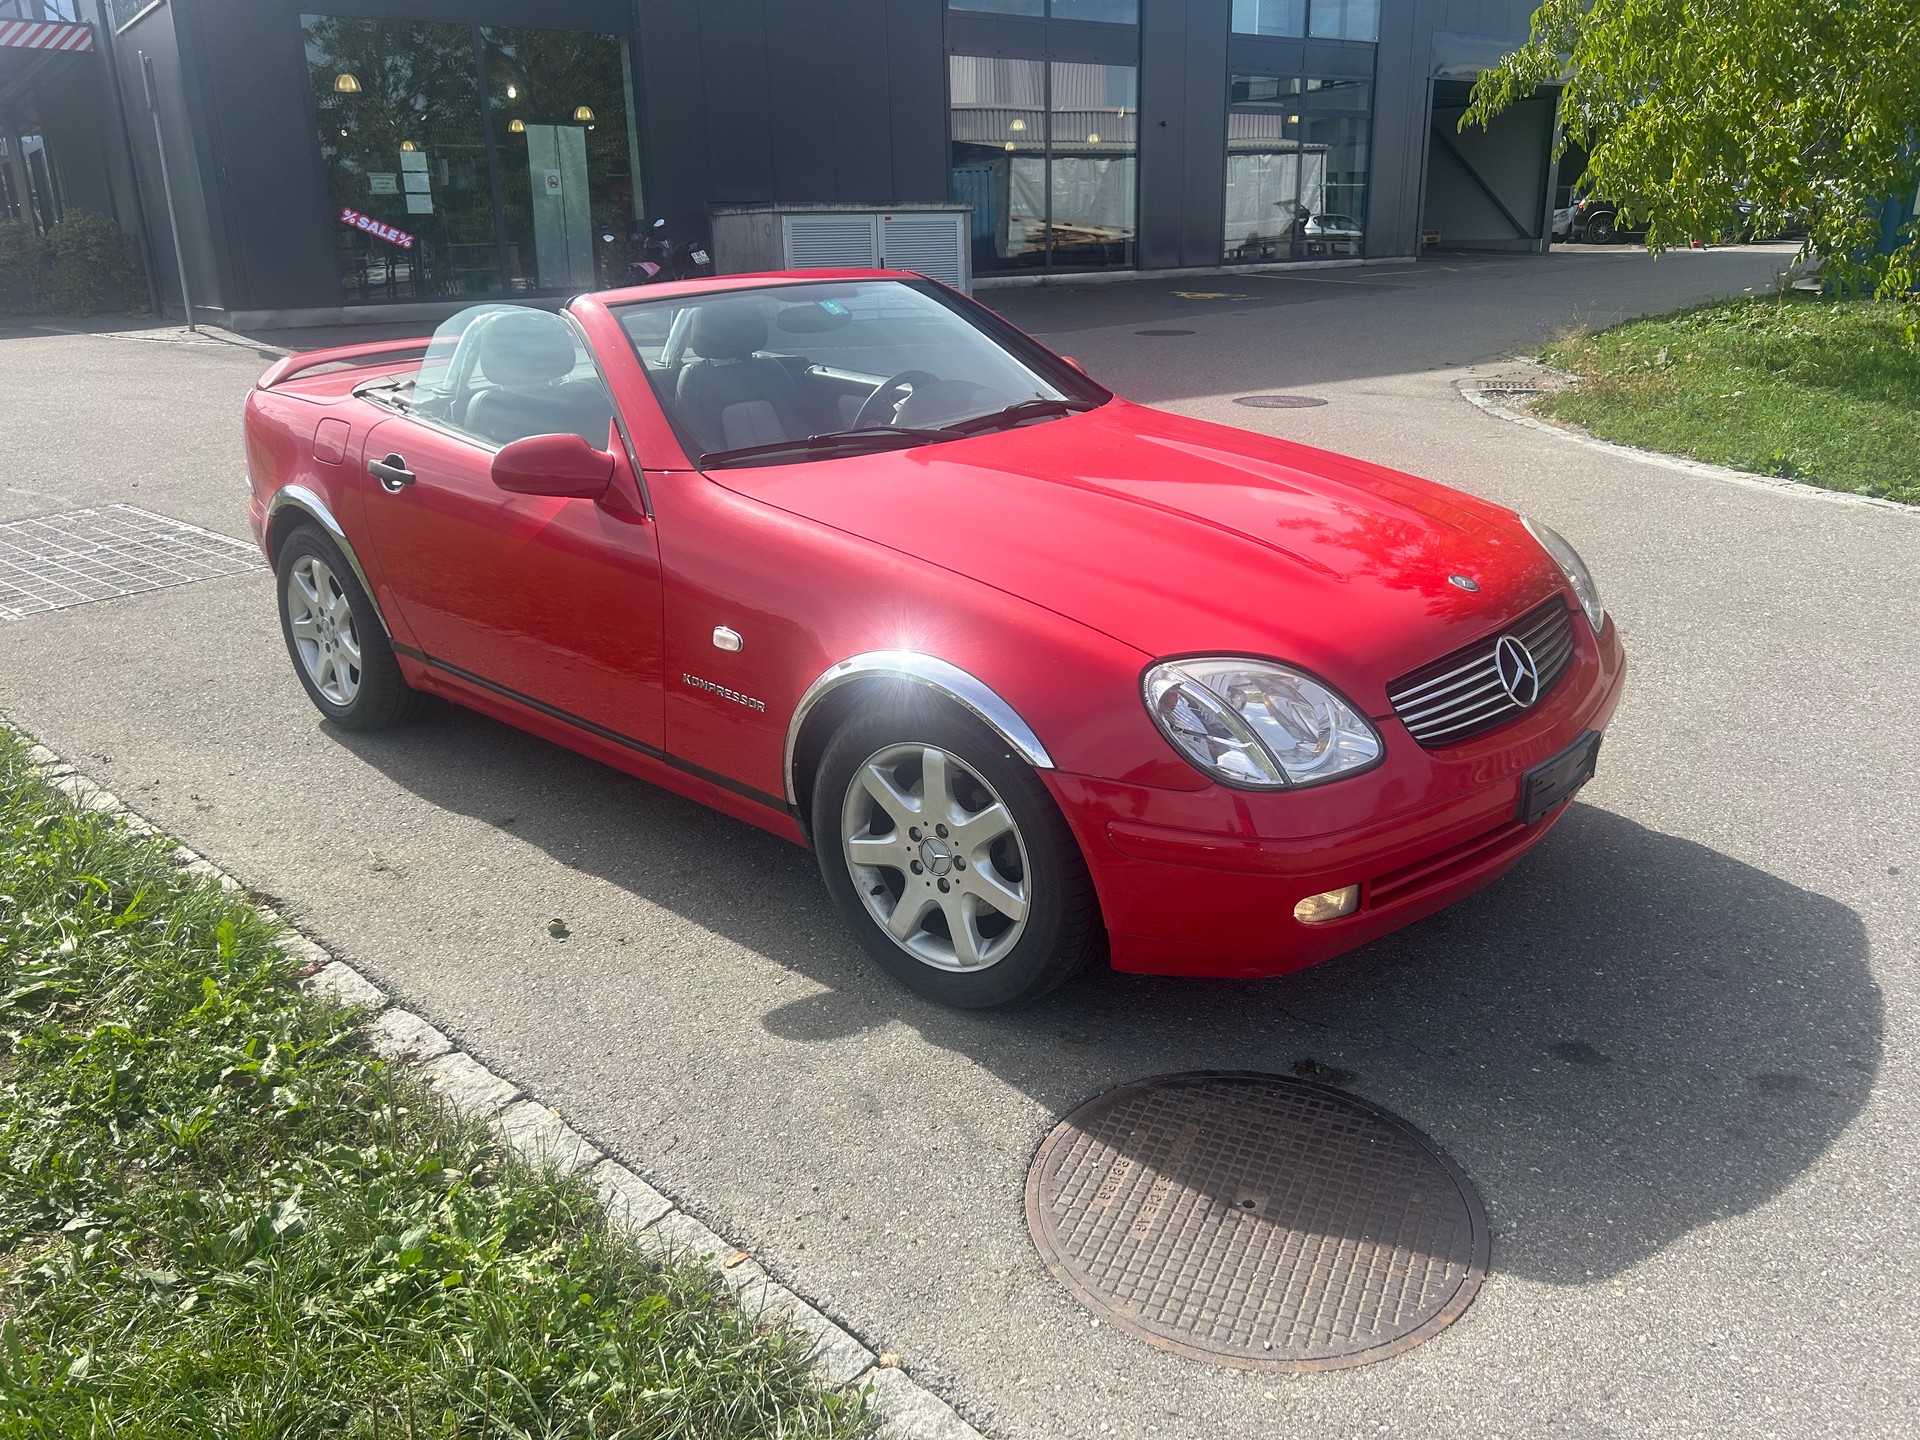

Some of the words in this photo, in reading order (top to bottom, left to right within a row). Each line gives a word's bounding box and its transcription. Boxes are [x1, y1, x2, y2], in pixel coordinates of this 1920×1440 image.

[683, 673, 765, 712] KOMPRESSOR
[1098, 1138, 1141, 1200] OBERBURG
[1134, 1218, 1151, 1233] AG
